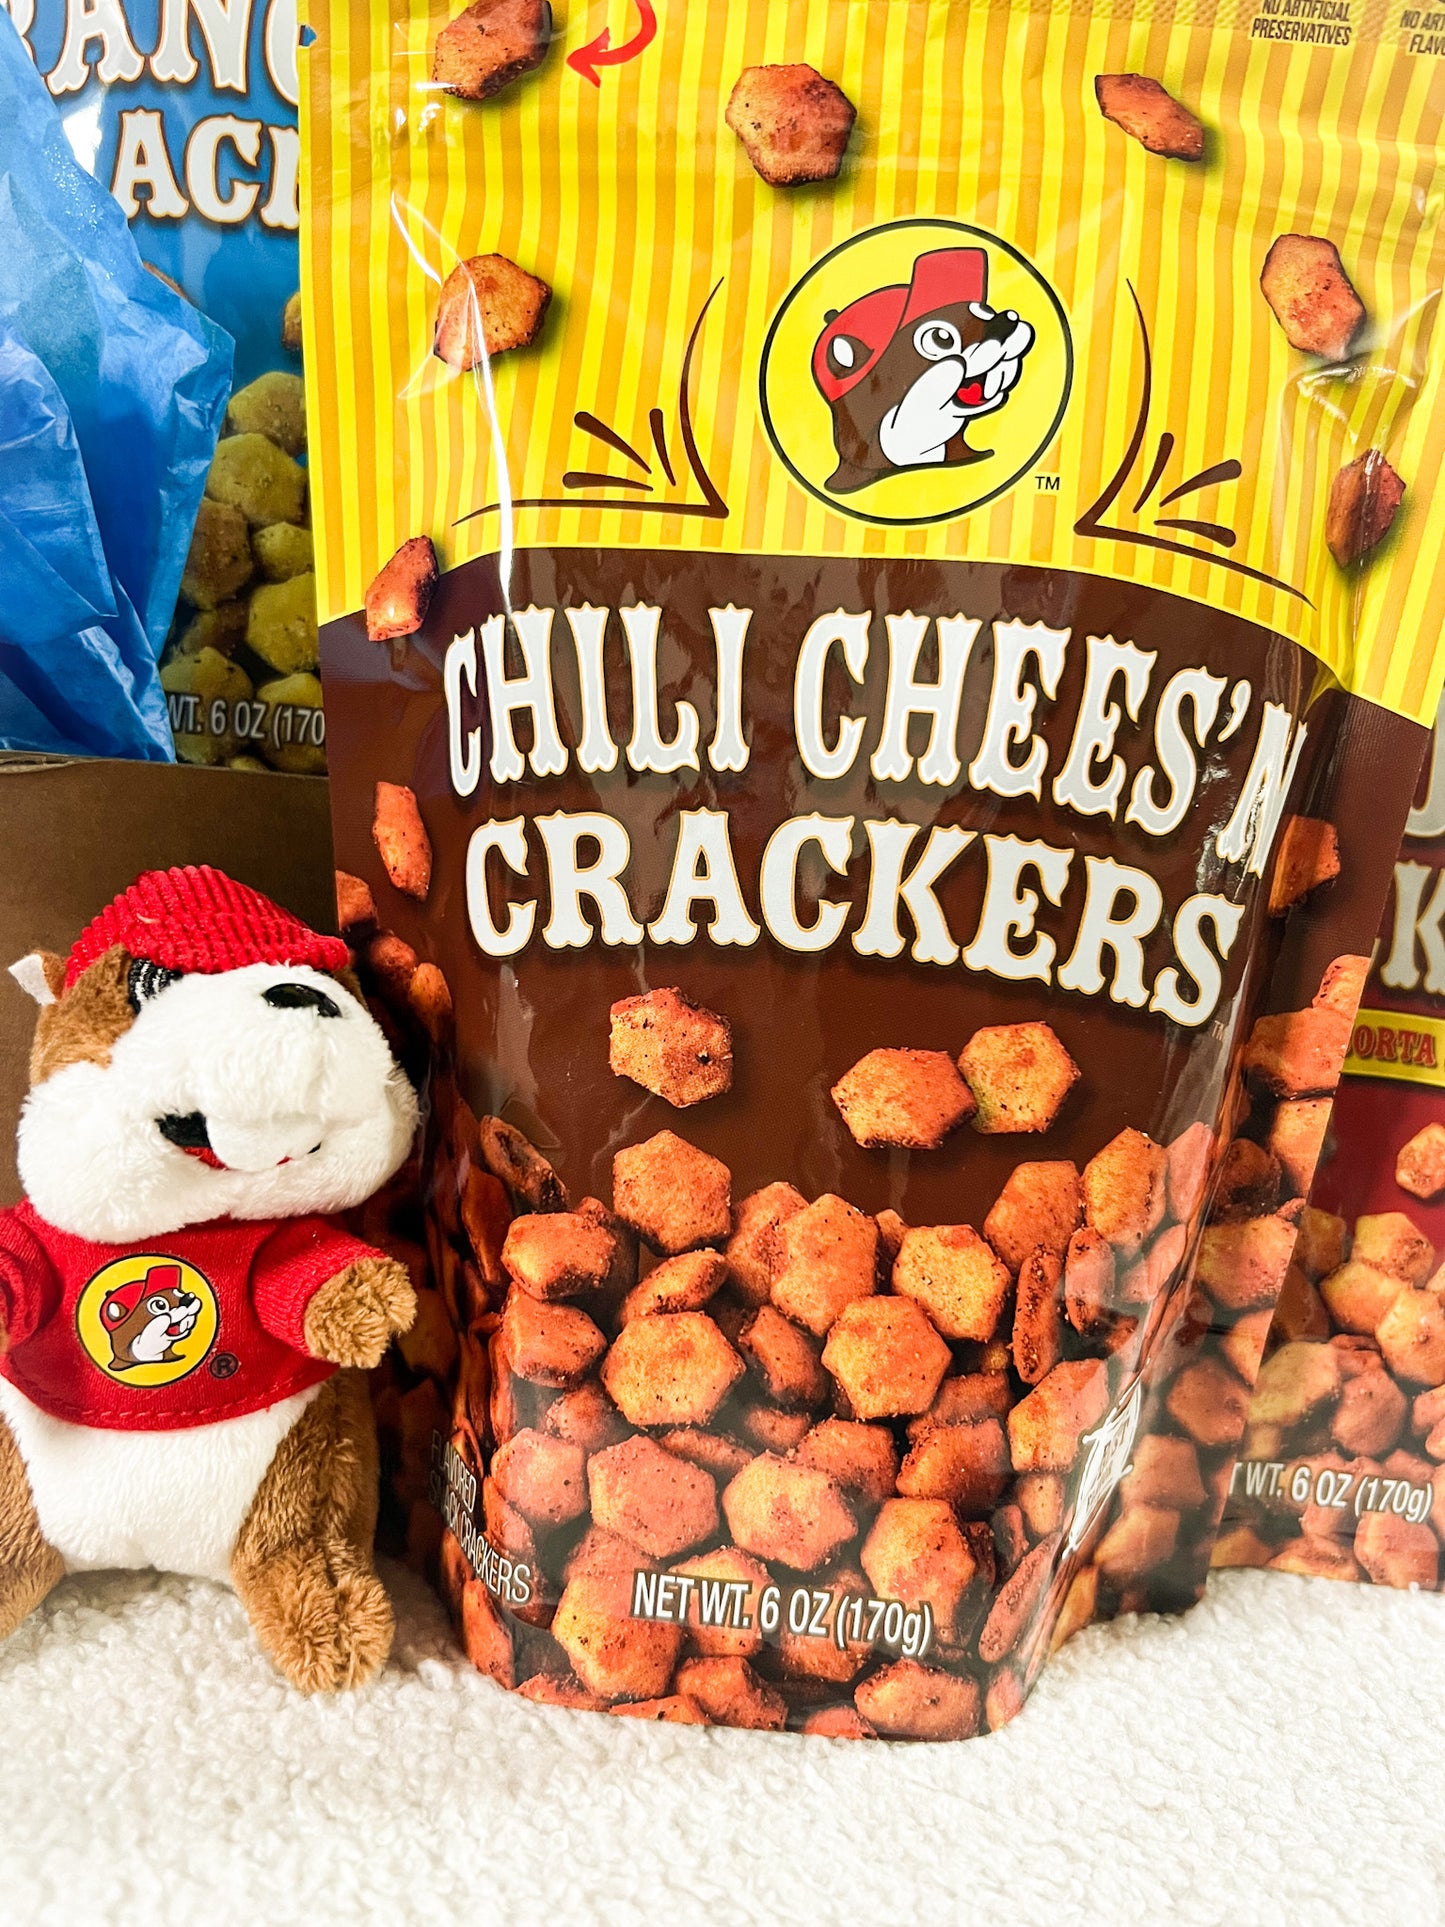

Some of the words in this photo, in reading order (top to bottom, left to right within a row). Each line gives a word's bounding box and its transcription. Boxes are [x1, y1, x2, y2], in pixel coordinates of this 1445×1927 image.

[1251, 18, 1351, 46] PRESERVATIVES
[1400, 9, 1420, 28] NO
[1034, 475, 1060, 490] TM
[211, 700, 226, 735] 6
[235, 701, 266, 739] OZ
[443, 602, 752, 798] CHILI
[465, 808, 1245, 1028] CRACKERS
[1246, 1462, 1284, 1497] WT.
[1291, 1466, 1311, 1501] 6
[1316, 1470, 1353, 1508] OZ
[1354, 1476, 1433, 1524] (170g)
[460, 1511, 531, 1603] CRACKERS
[632, 1571, 694, 1620] NET
[701, 1579, 750, 1627] WT.
[761, 1586, 780, 1629] 6
[788, 1589, 831, 1634] OZ
[836, 1595, 931, 1656] (170g)
